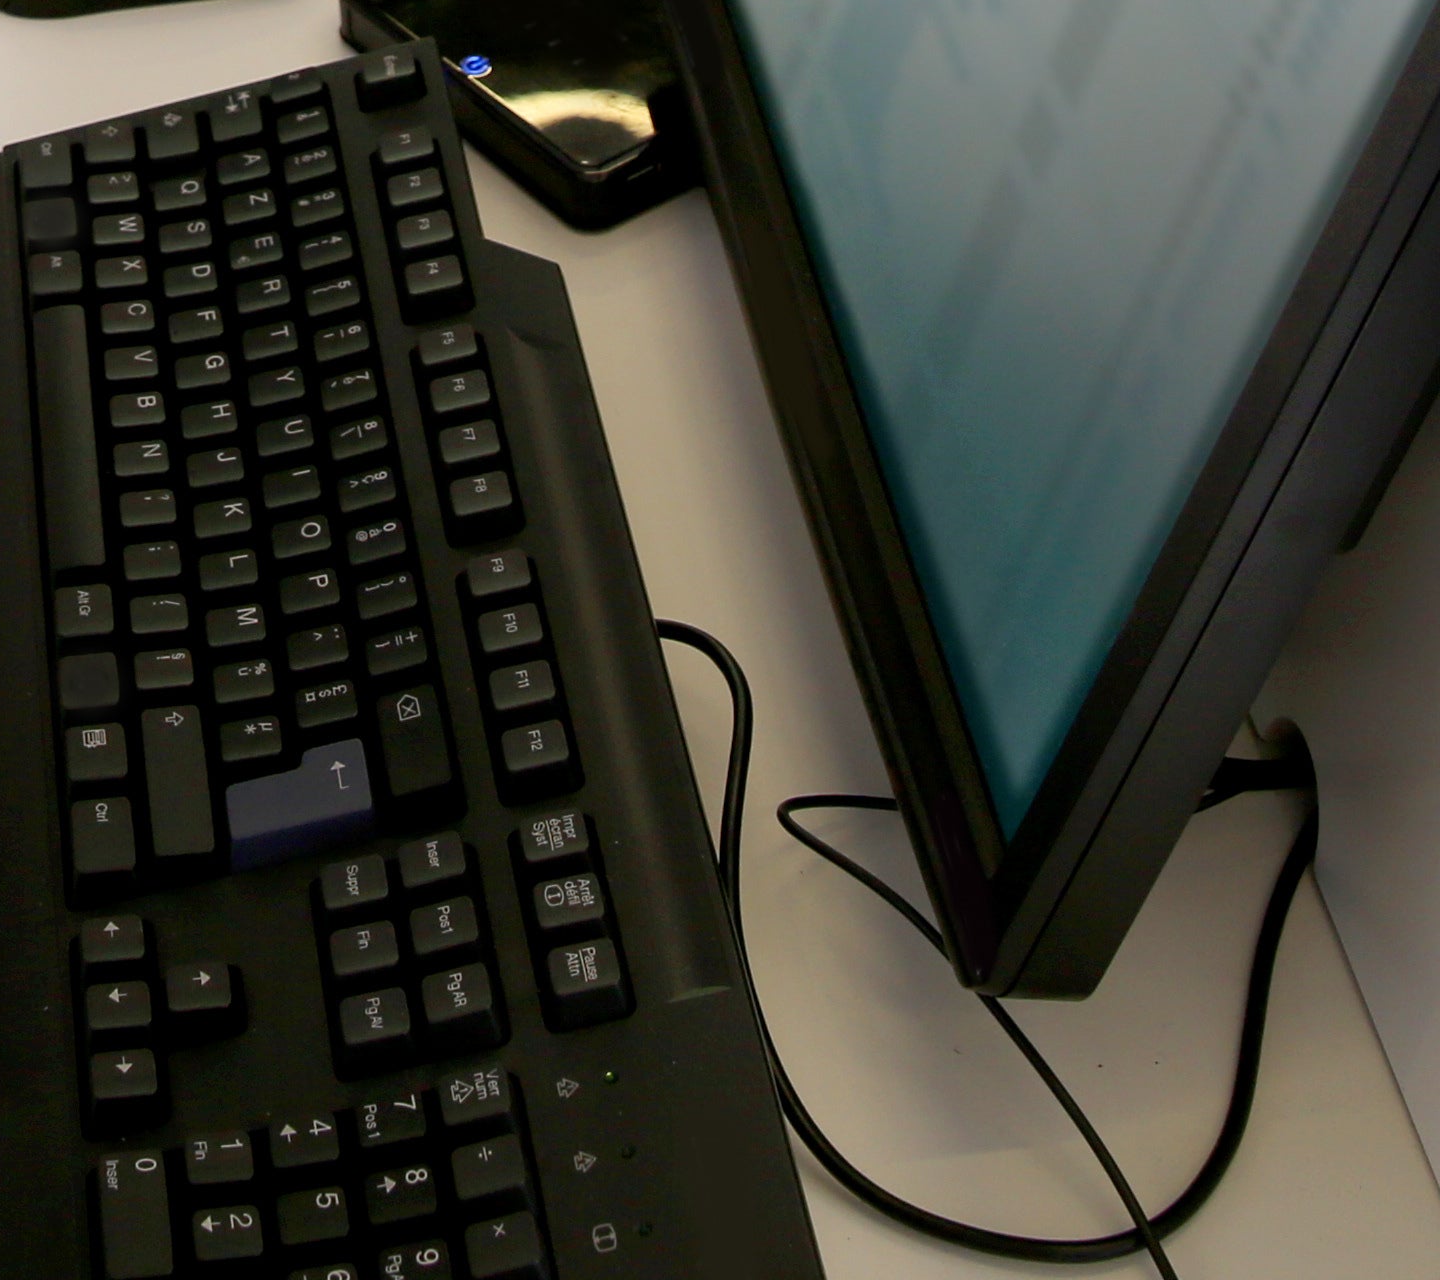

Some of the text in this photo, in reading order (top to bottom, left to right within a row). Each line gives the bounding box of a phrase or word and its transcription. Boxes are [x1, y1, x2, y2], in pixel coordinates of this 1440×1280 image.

[399, 133, 411, 145] F1
[244, 154, 261, 166] A
[181, 180, 199, 194] Q
[409, 175, 421, 187] F2
[249, 192, 269, 206] Z
[118, 216, 138, 232] W
[187, 221, 206, 233] S
[418, 218, 430, 230] F3
[254, 236, 274, 249] E
[123, 259, 142, 271] X
[192, 264, 211, 278] D
[426, 262, 439, 275] F4
[263, 279, 282, 294] R
[128, 303, 147, 316] C
[197, 310, 216, 321] F
[270, 326, 290, 337] T
[442, 331, 455, 345] F5
[134, 350, 153, 362] V
[205, 355, 225, 369] G
[276, 370, 296, 382] Y
[452, 378, 465, 392] F6
[137, 396, 156, 408] B
[211, 403, 231, 419] H
[284, 419, 305, 434] U
[364, 421, 378, 430] 8
[462, 428, 476, 440] F7
[141, 443, 162, 458] N
[217, 451, 237, 462] J
[373, 471, 388, 480] 9
[473, 478, 487, 493] F8
[223, 502, 244, 517] K
[301, 522, 321, 538] O
[229, 554, 248, 568] L
[491, 557, 505, 573] F9
[308, 574, 329, 588] P
[77, 590, 91, 617] Alt Gr
[236, 607, 258, 626] M
[503, 612, 518, 633] F10
[254, 662, 267, 675] %
[515, 669, 529, 689] F11
[528, 729, 543, 751] F12
[95, 803, 109, 823] Ctrl
[532, 822, 549, 847] Syst
[561, 814, 577, 840] Impr
[425, 840, 440, 868] Inser
[345, 865, 359, 897] Suppr
[356, 930, 370, 951] Fin
[565, 952, 580, 977] Attn
[581, 947, 598, 981] Pause
[473, 1072, 489, 1101] num
[485, 1068, 501, 1097] Verr
[393, 1094, 417, 1111] 7
[309, 1119, 332, 1136] 4
[193, 1141, 208, 1161] Fin
[220, 1138, 244, 1149] 1
[135, 1158, 158, 1172] 0
[105, 1160, 120, 1190] Inser
[404, 1168, 428, 1185] 8
[315, 1193, 340, 1209] 5
[229, 1212, 253, 1229] 2
[415, 1248, 440, 1266] 9
